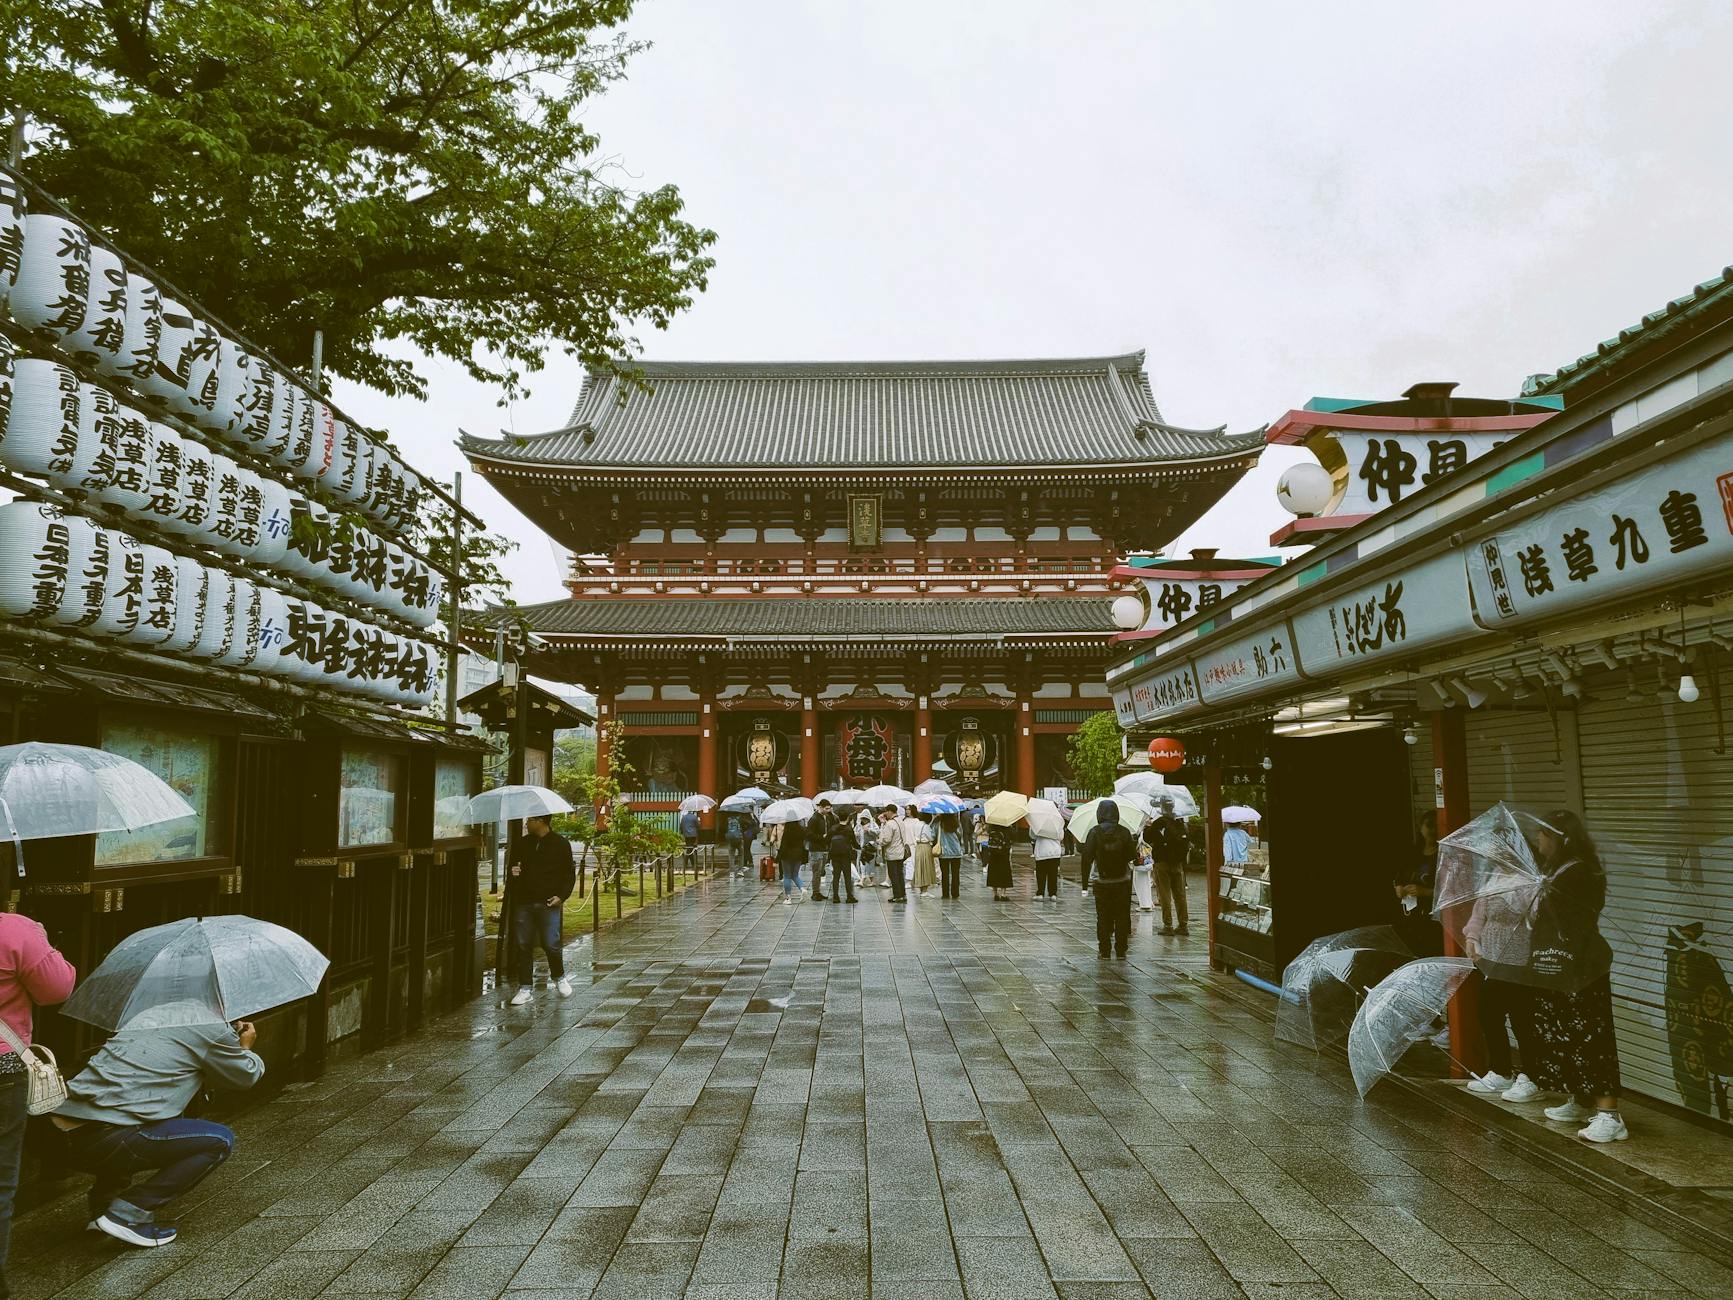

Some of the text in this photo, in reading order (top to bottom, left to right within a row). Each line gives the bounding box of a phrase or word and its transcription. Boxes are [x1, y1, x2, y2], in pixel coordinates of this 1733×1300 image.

[110, 417, 148, 493] 浅草店
[138, 440, 182, 516] 浅草店
[176, 458, 210, 526] 浅草店
[207, 474, 239, 539] 浅草店
[230, 485, 262, 548] 浅草店
[1517, 490, 1709, 598] 浅草九重
[142, 565, 175, 629] 浅草店
[1485, 544, 1513, 613] 仲見世
[1252, 636, 1286, 678] 助六
